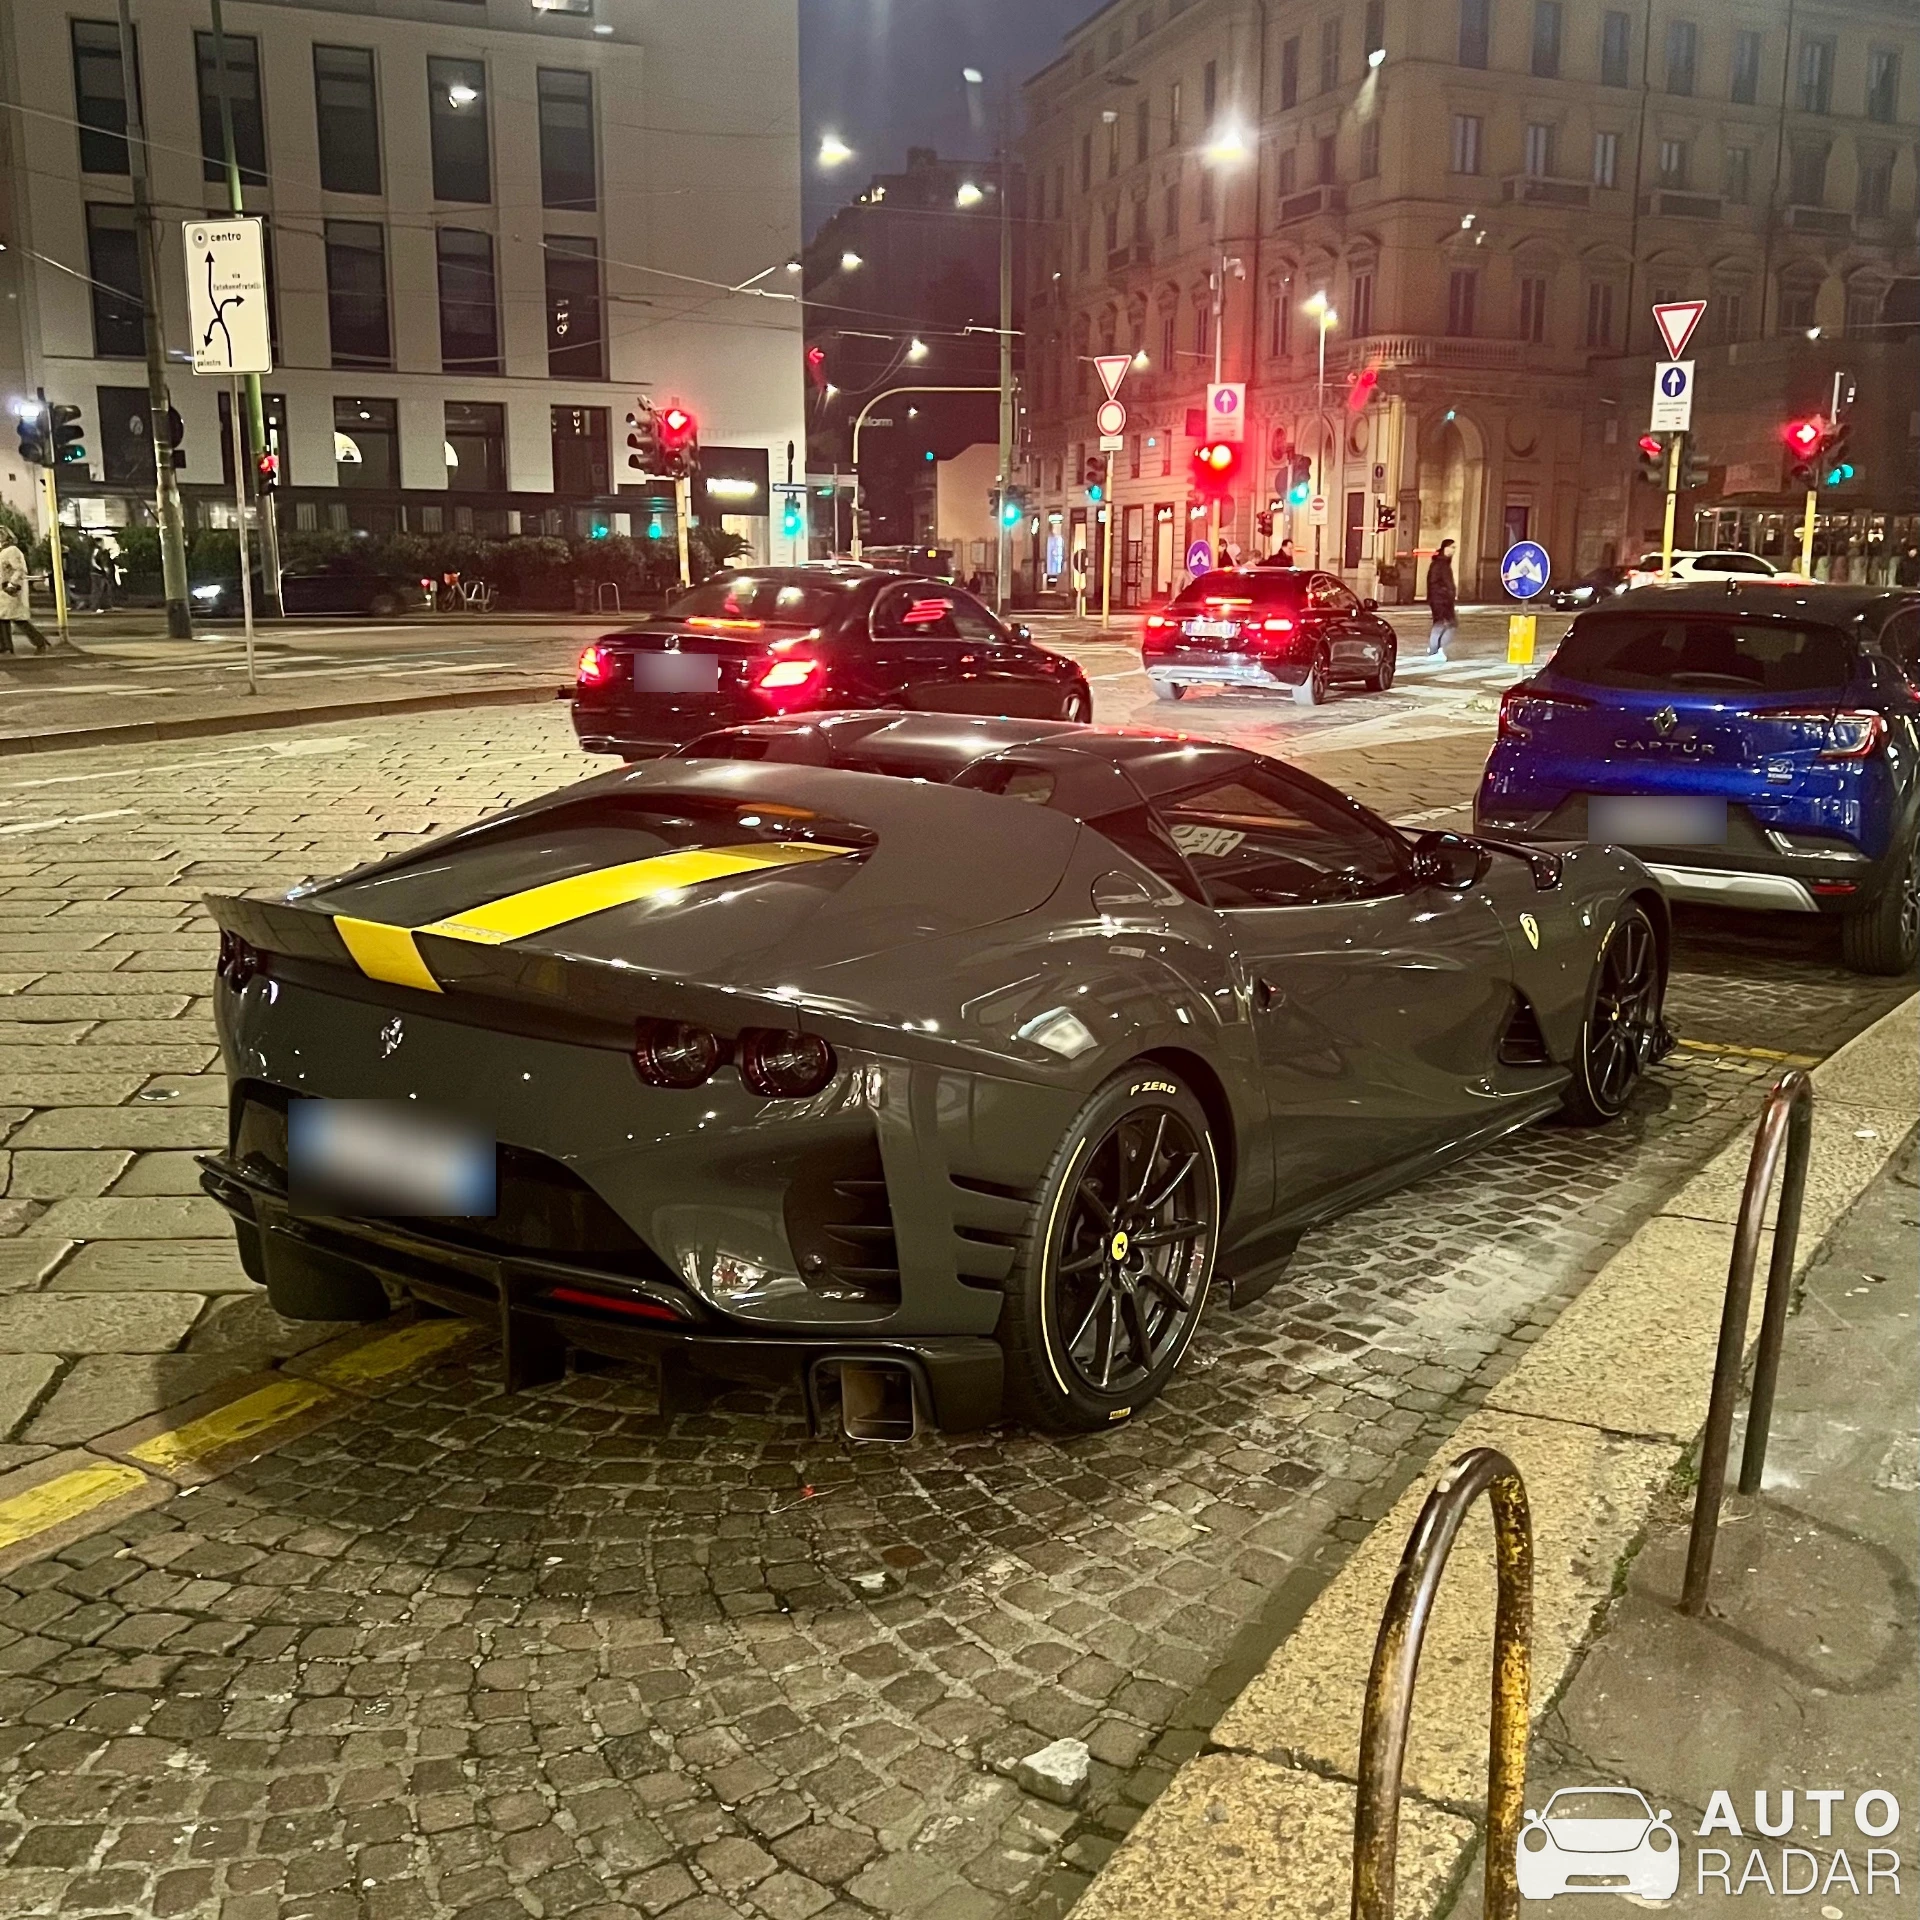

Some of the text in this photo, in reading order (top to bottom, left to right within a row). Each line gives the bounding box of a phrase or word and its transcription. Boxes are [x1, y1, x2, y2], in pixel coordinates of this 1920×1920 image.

[210, 232, 242, 242] centro
[1614, 739, 1717, 755] CAPTUR
[1141, 1081, 1177, 1094] ZERO
